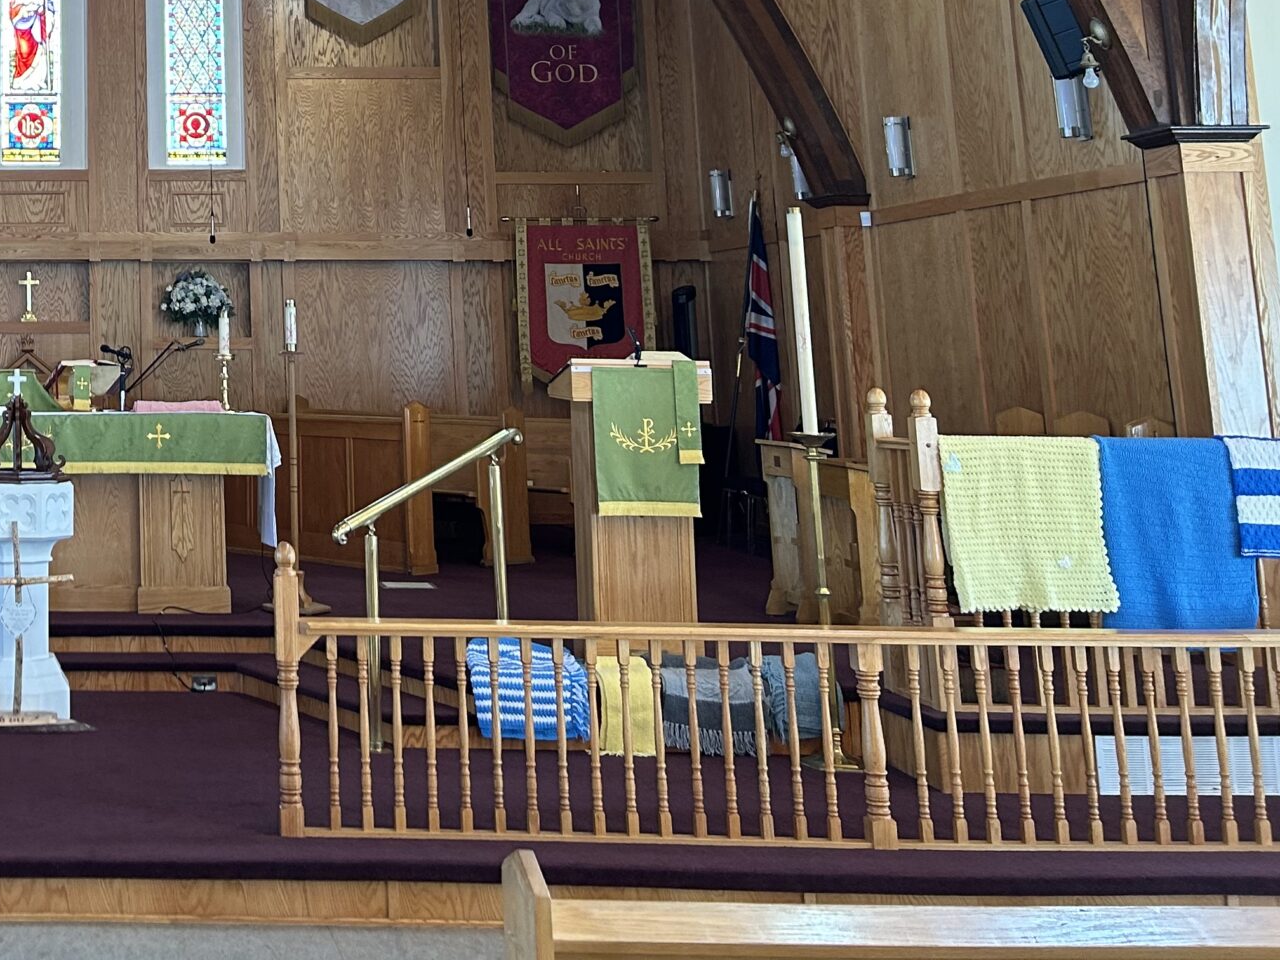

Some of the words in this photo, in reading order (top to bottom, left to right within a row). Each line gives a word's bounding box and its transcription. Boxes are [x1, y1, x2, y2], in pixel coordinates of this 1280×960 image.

[549, 44, 577, 60] OF
[531, 61, 598, 83] GOD
[537, 238, 563, 251] ALL
[562, 252, 602, 261] CHURCH
